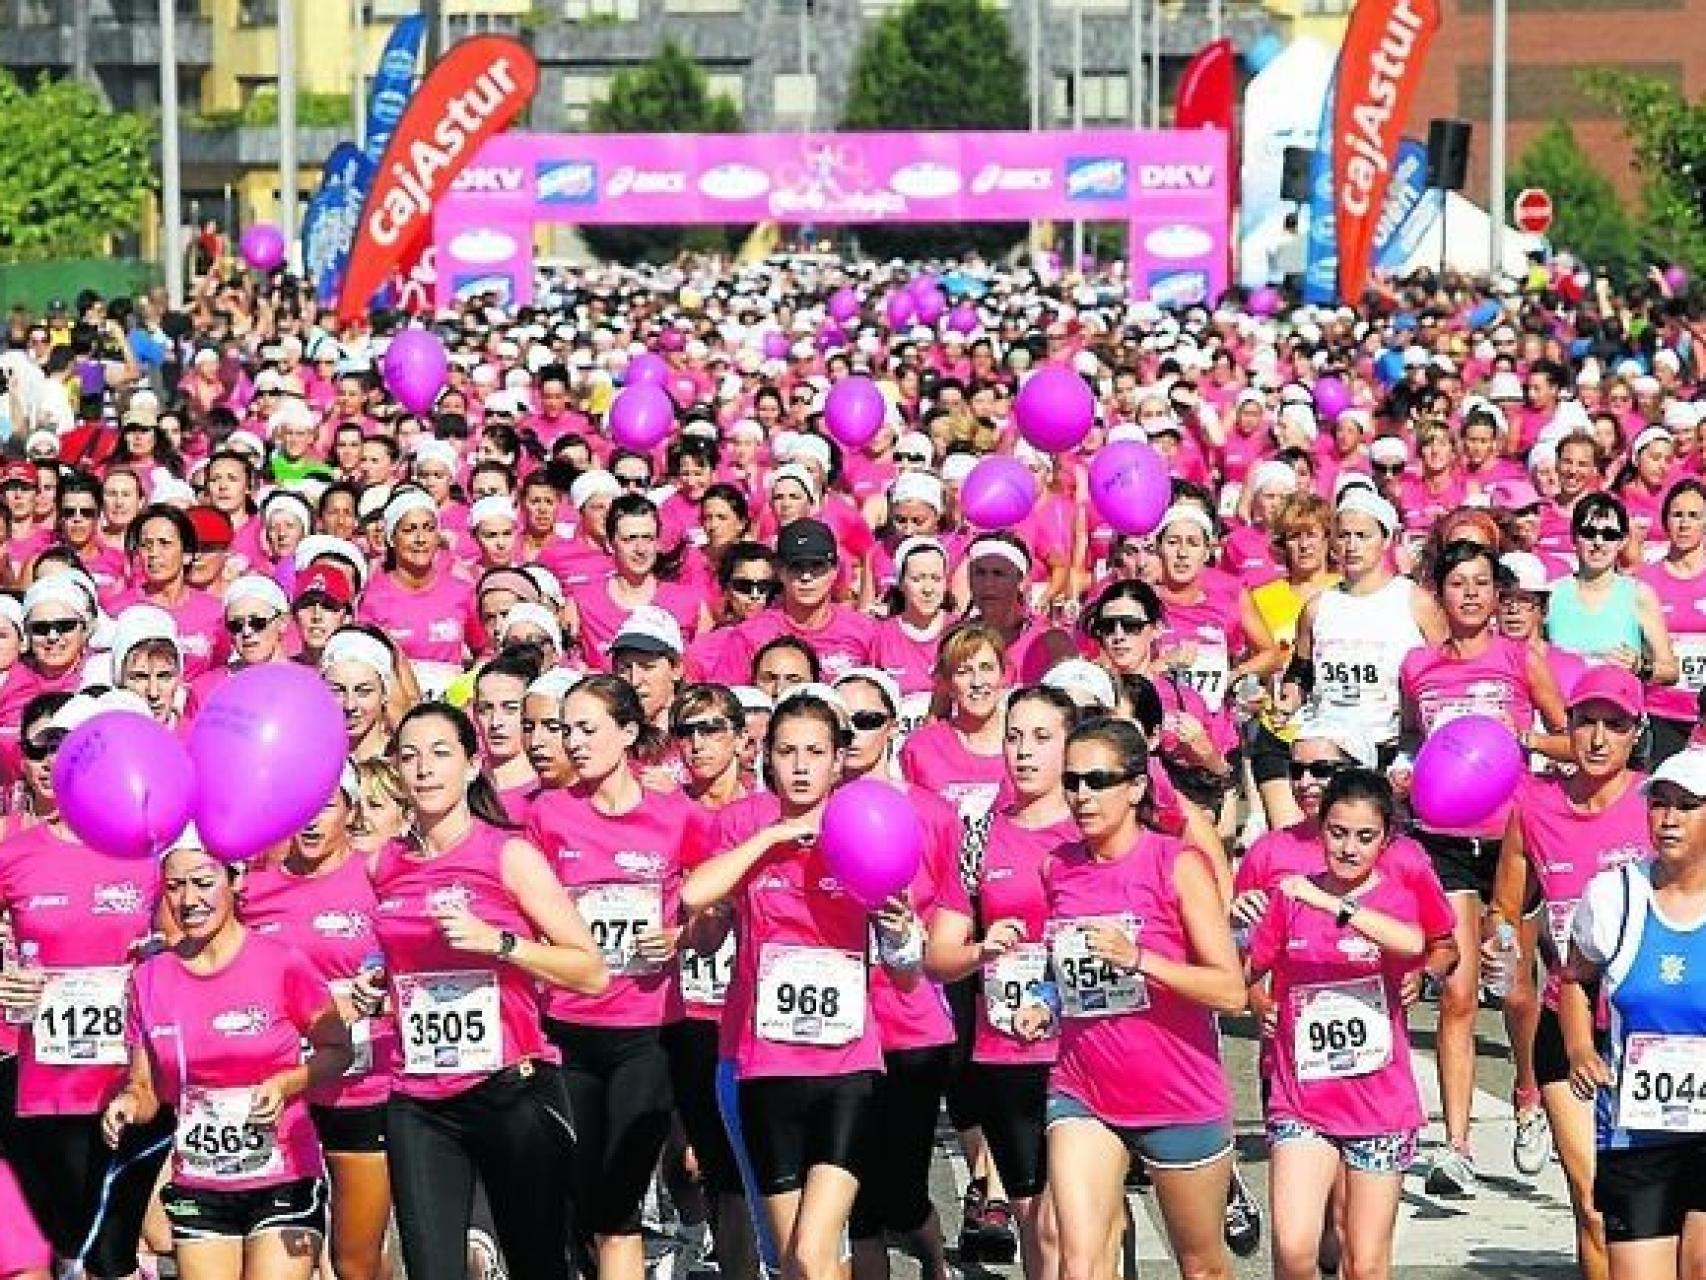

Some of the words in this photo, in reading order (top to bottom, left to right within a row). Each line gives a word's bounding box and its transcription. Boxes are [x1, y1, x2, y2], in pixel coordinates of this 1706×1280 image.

[1341, 0, 1423, 216] cajAstur
[369, 58, 518, 246] cajAstur
[1140, 165, 1215, 189] DKV
[777, 983, 840, 1018] 968
[41, 1005, 122, 1037] 1128
[410, 1010, 486, 1046] 3505
[1309, 1017, 1367, 1053] 969
